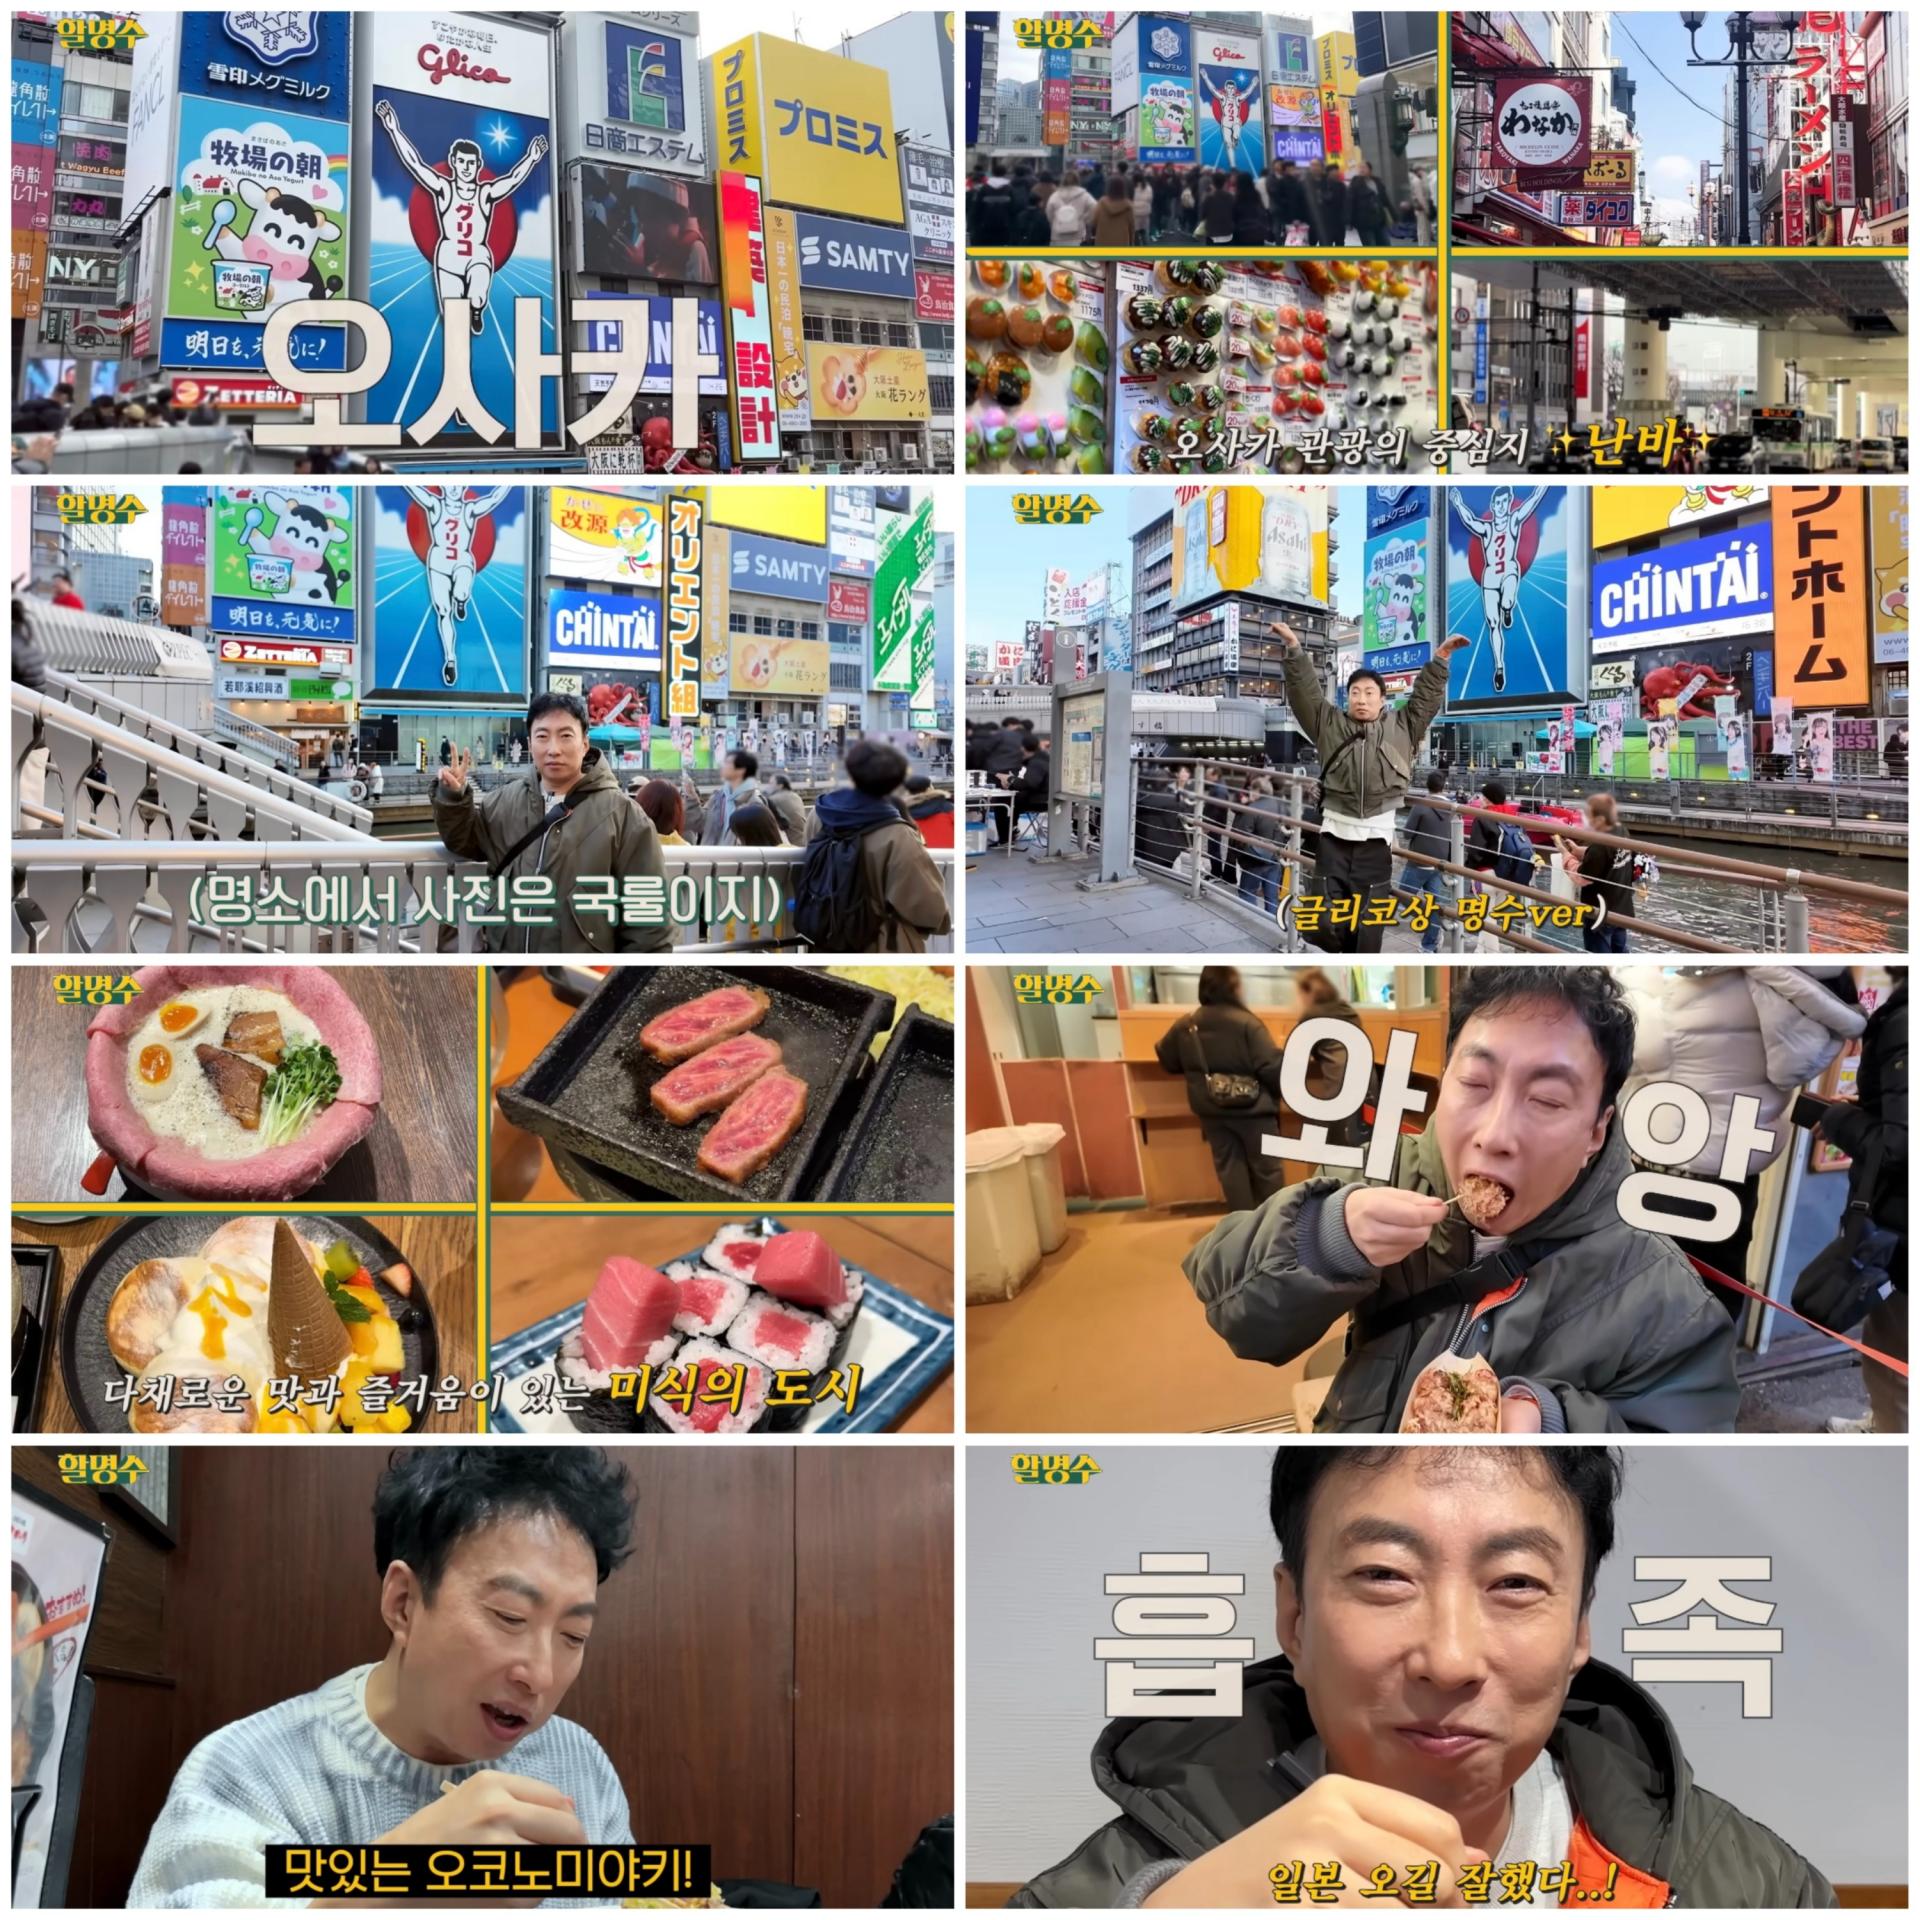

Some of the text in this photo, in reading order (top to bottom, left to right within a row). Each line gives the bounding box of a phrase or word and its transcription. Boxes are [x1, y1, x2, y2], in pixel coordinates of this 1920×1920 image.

[417, 43, 511, 85] Glico
[1212, 47, 1246, 62] Glico
[1321, 37, 1334, 80] プロミス
[207, 62, 331, 100] 雪印メグミルク
[723, 49, 750, 165] プロミス
[1500, 107, 1574, 137] わなか
[585, 122, 704, 165] 日商エステム
[774, 97, 888, 160] プロミス
[1276, 134, 1322, 157] CHINTAI
[68, 161, 100, 174] Wagyu
[210, 139, 322, 181] 牧場の朝
[1561, 141, 1584, 165] WANAKA
[230, 168, 258, 178] Makiba
[268, 173, 283, 181] Asa
[455, 203, 475, 257] グリコ
[49, 255, 98, 280] NY
[826, 240, 909, 277] SAMTY
[443, 517, 460, 562] グリコ
[560, 508, 609, 535] 改源
[1266, 525, 1307, 552] Asahi
[755, 553, 827, 586] SAMTY
[1373, 544, 1416, 571] 牧場の朝
[1493, 532, 1506, 574] グリコ
[1600, 541, 1760, 629] CHINTAI
[555, 600, 659, 651] CHINTAI
[669, 500, 702, 718] オリエント組
[1833, 734, 1879, 750] BEST
[1838, 720, 1873, 735] THE
